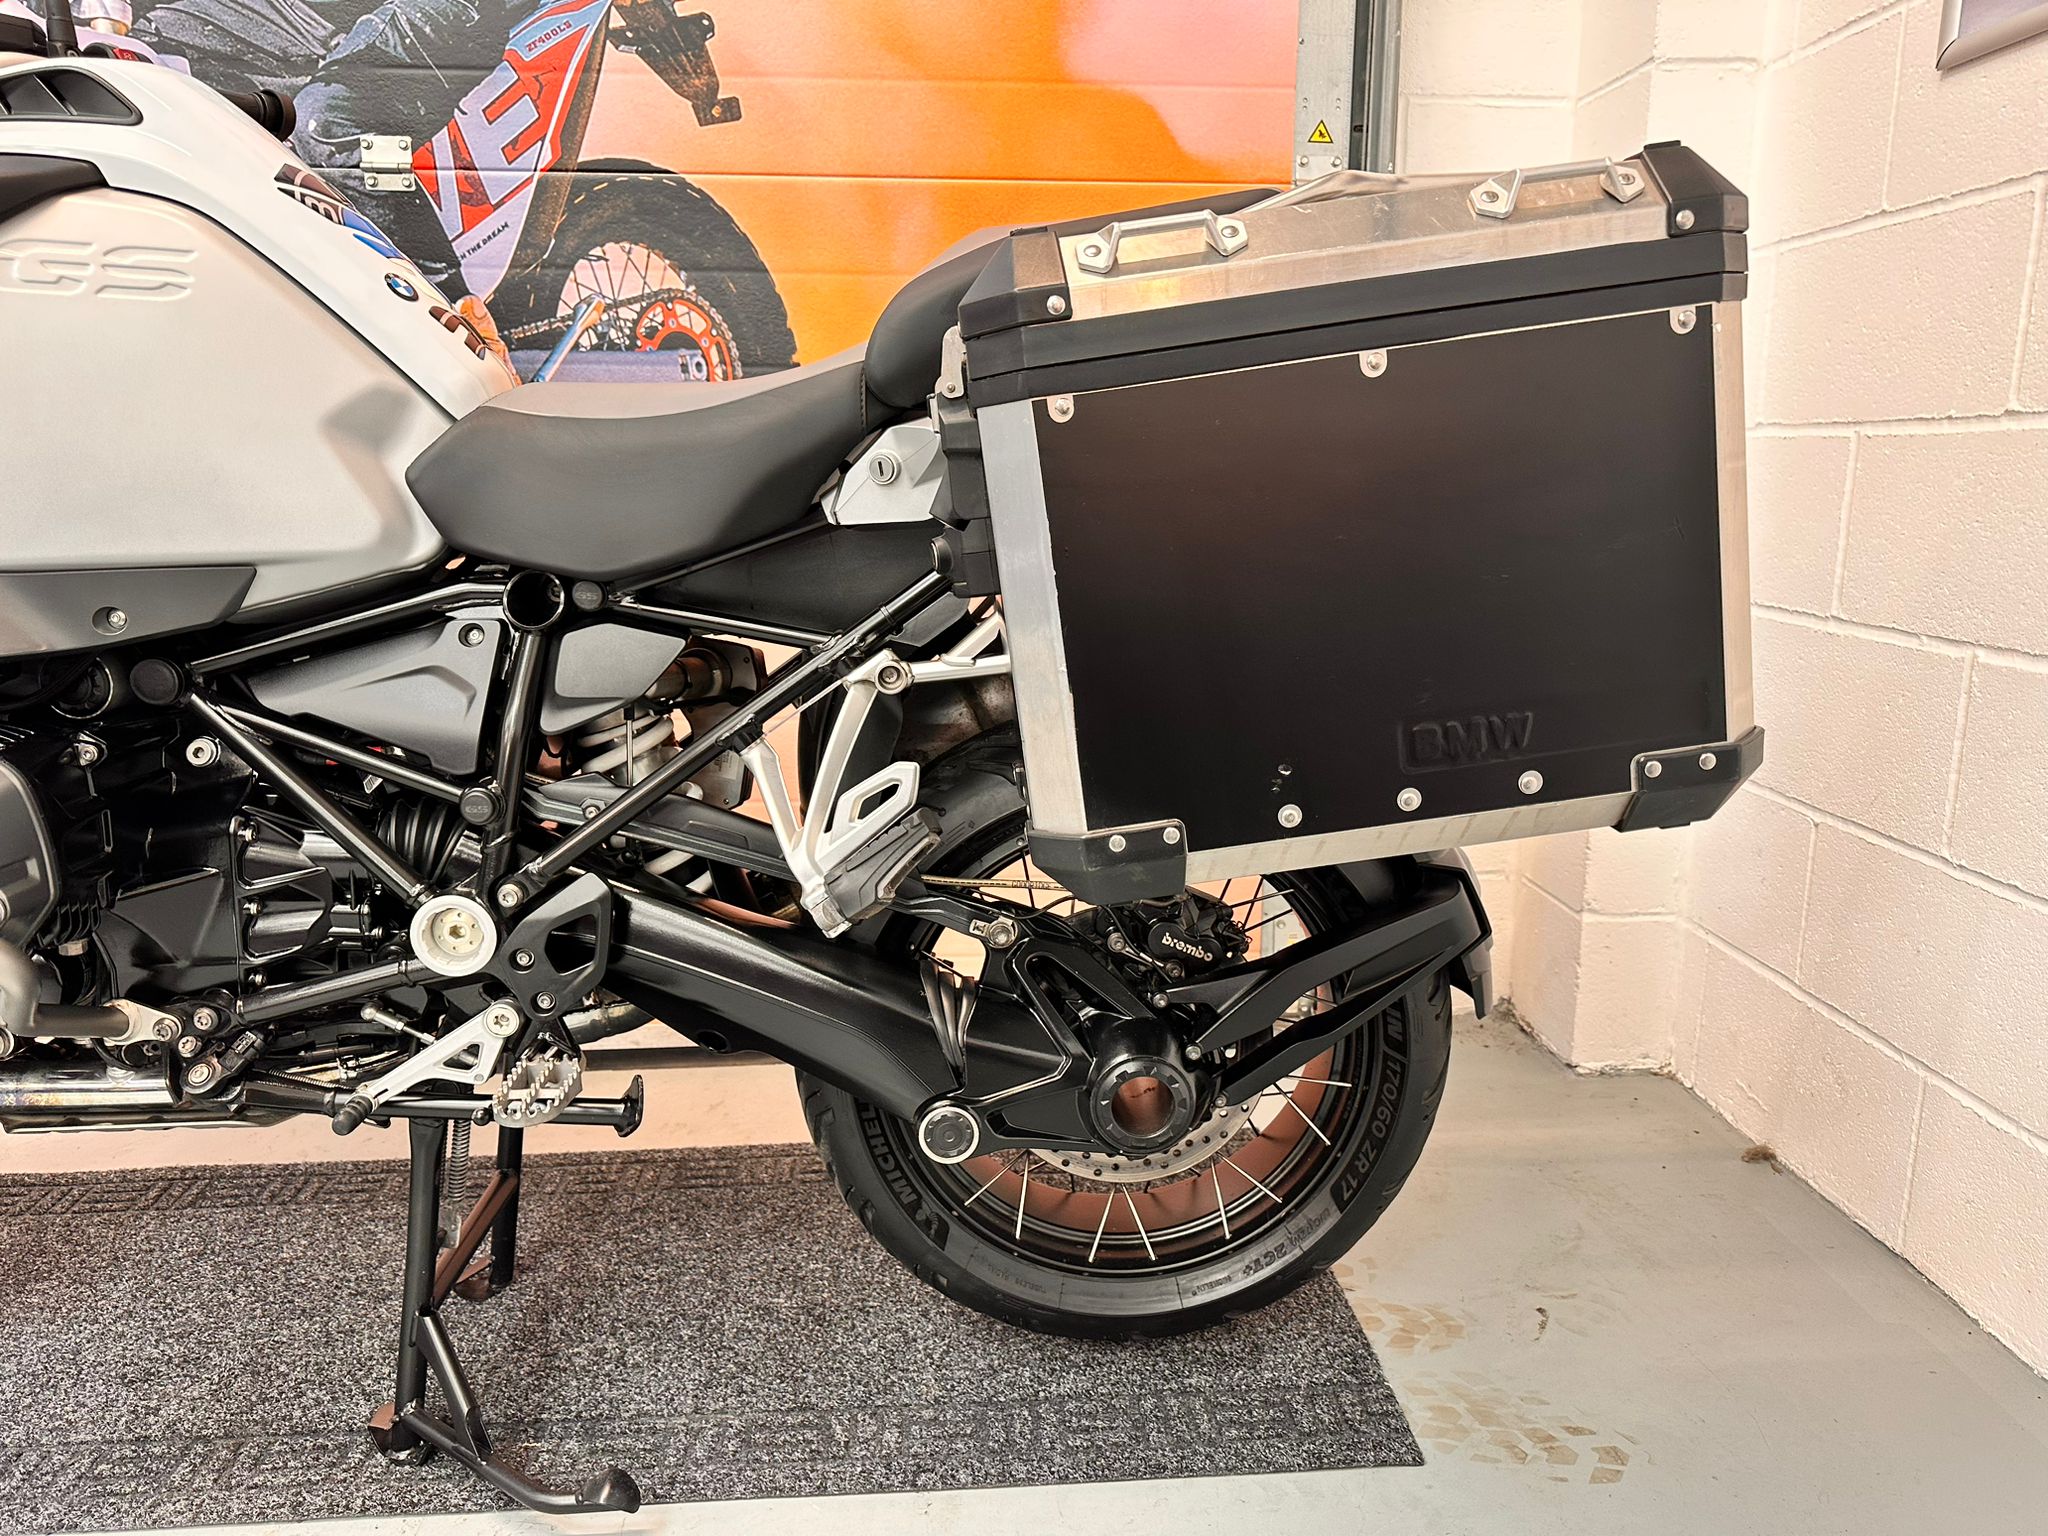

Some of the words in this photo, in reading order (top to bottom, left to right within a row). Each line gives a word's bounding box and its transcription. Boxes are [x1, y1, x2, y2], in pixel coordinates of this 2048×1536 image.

[413, 60, 543, 241] VE
[466, 242, 482, 256] THE
[481, 221, 510, 246] DREAM
[0, 238, 199, 302] GS
[1408, 711, 1534, 763] BMW
[1161, 931, 1213, 962] brembo
[1371, 1057, 1402, 1139] 170/60
[862, 1104, 918, 1205] MICHEL
[1353, 1139, 1379, 1175] ZR
[1341, 1174, 1360, 1201] 17
